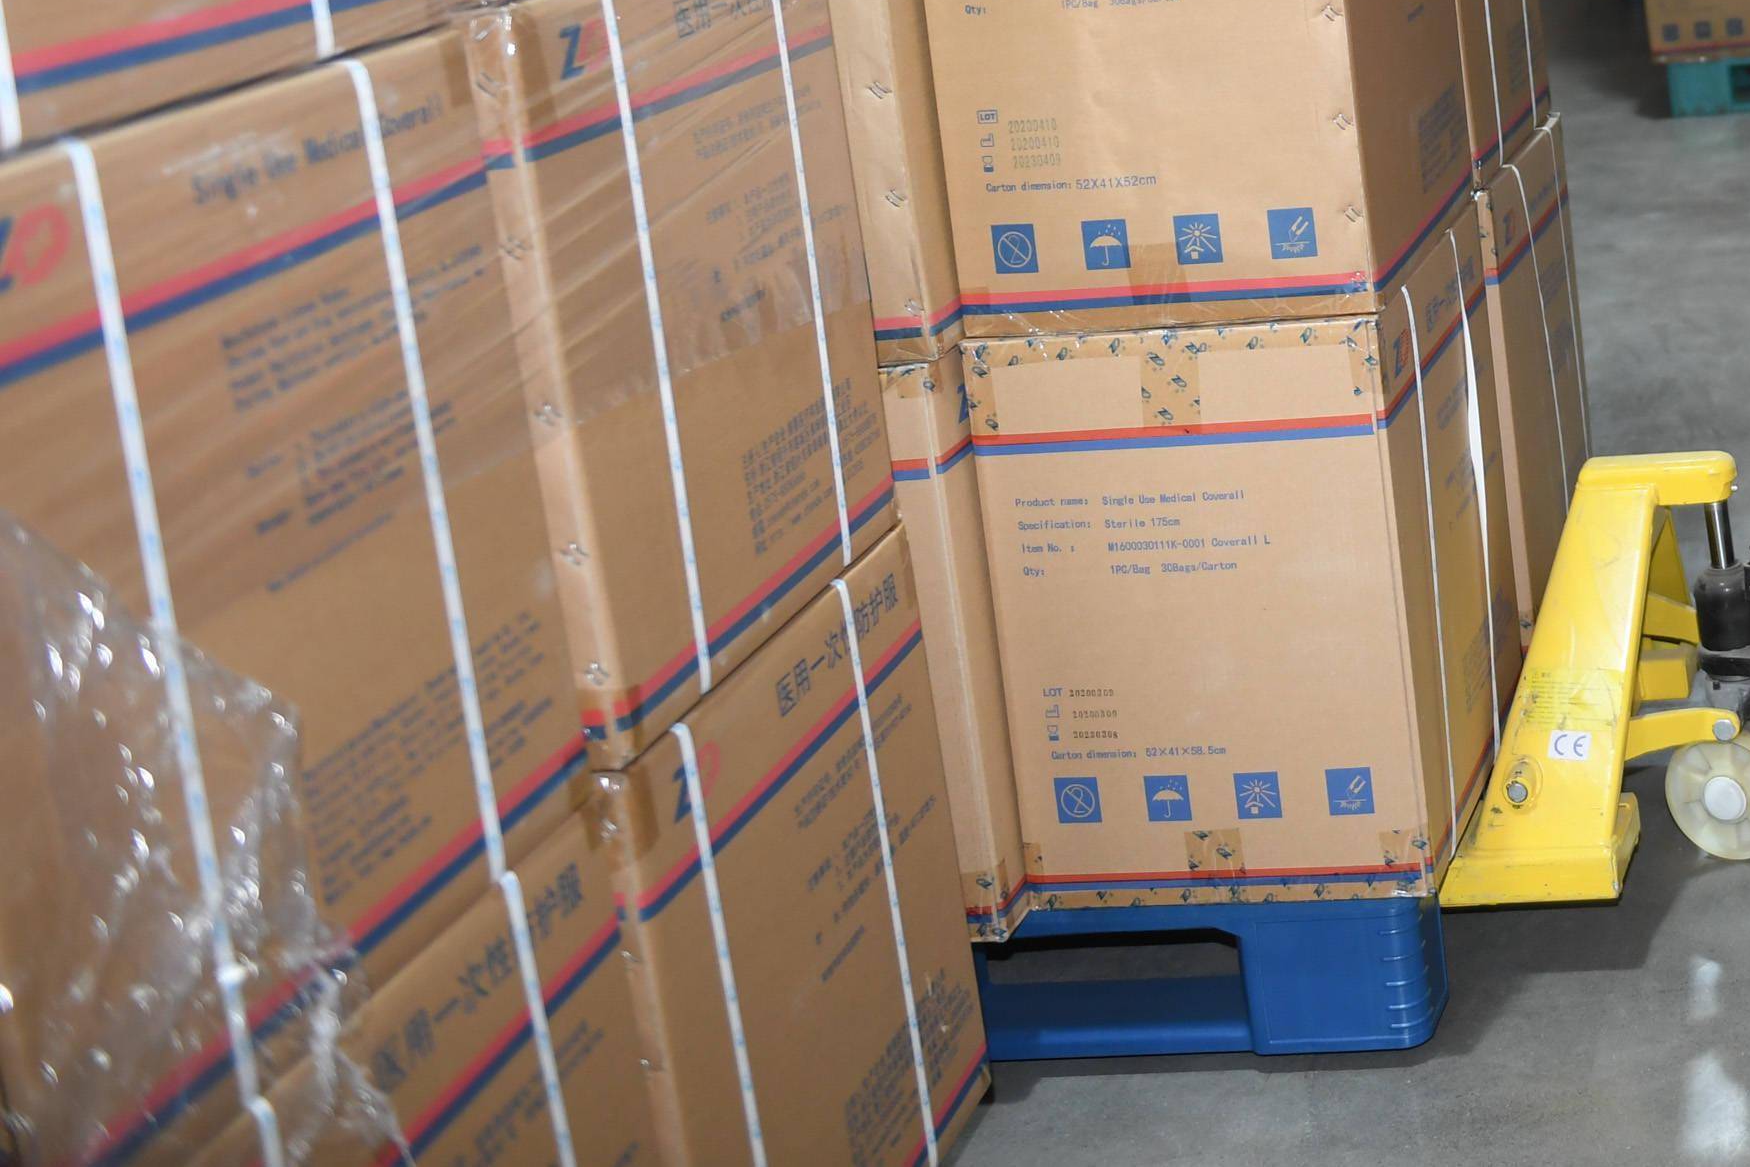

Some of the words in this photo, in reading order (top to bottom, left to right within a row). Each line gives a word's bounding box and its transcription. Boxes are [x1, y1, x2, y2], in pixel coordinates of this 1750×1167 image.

[964, 4, 988, 17] Qty:
[979, 112, 997, 122] LOT
[985, 182, 1017, 193] Carton
[1015, 496, 1056, 508] Product
[1060, 497, 1089, 507] name:
[1102, 494, 1135, 506] Single
[1138, 493, 1156, 505] Use
[1159, 491, 1197, 504] Medical
[1202, 489, 1246, 501] Coverall
[1018, 518, 1092, 532] Specification:
[1104, 517, 1146, 529] Sterile
[1151, 516, 1181, 528] 175cm
[1021, 543, 1044, 554] Item
[1047, 542, 1063, 553] No.
[1211, 534, 1259, 548] Coverall
[1263, 535, 1271, 546] L
[1023, 564, 1046, 577] Qty:
[1109, 562, 1151, 576] 1PC/Bag
[1160, 559, 1238, 573] 30Bags/Carton
[1042, 687, 1063, 698] LOT
[1553, 733, 1588, 758] CE
[1051, 750, 1083, 761] Carton
[1086, 749, 1138, 760] dimension:
